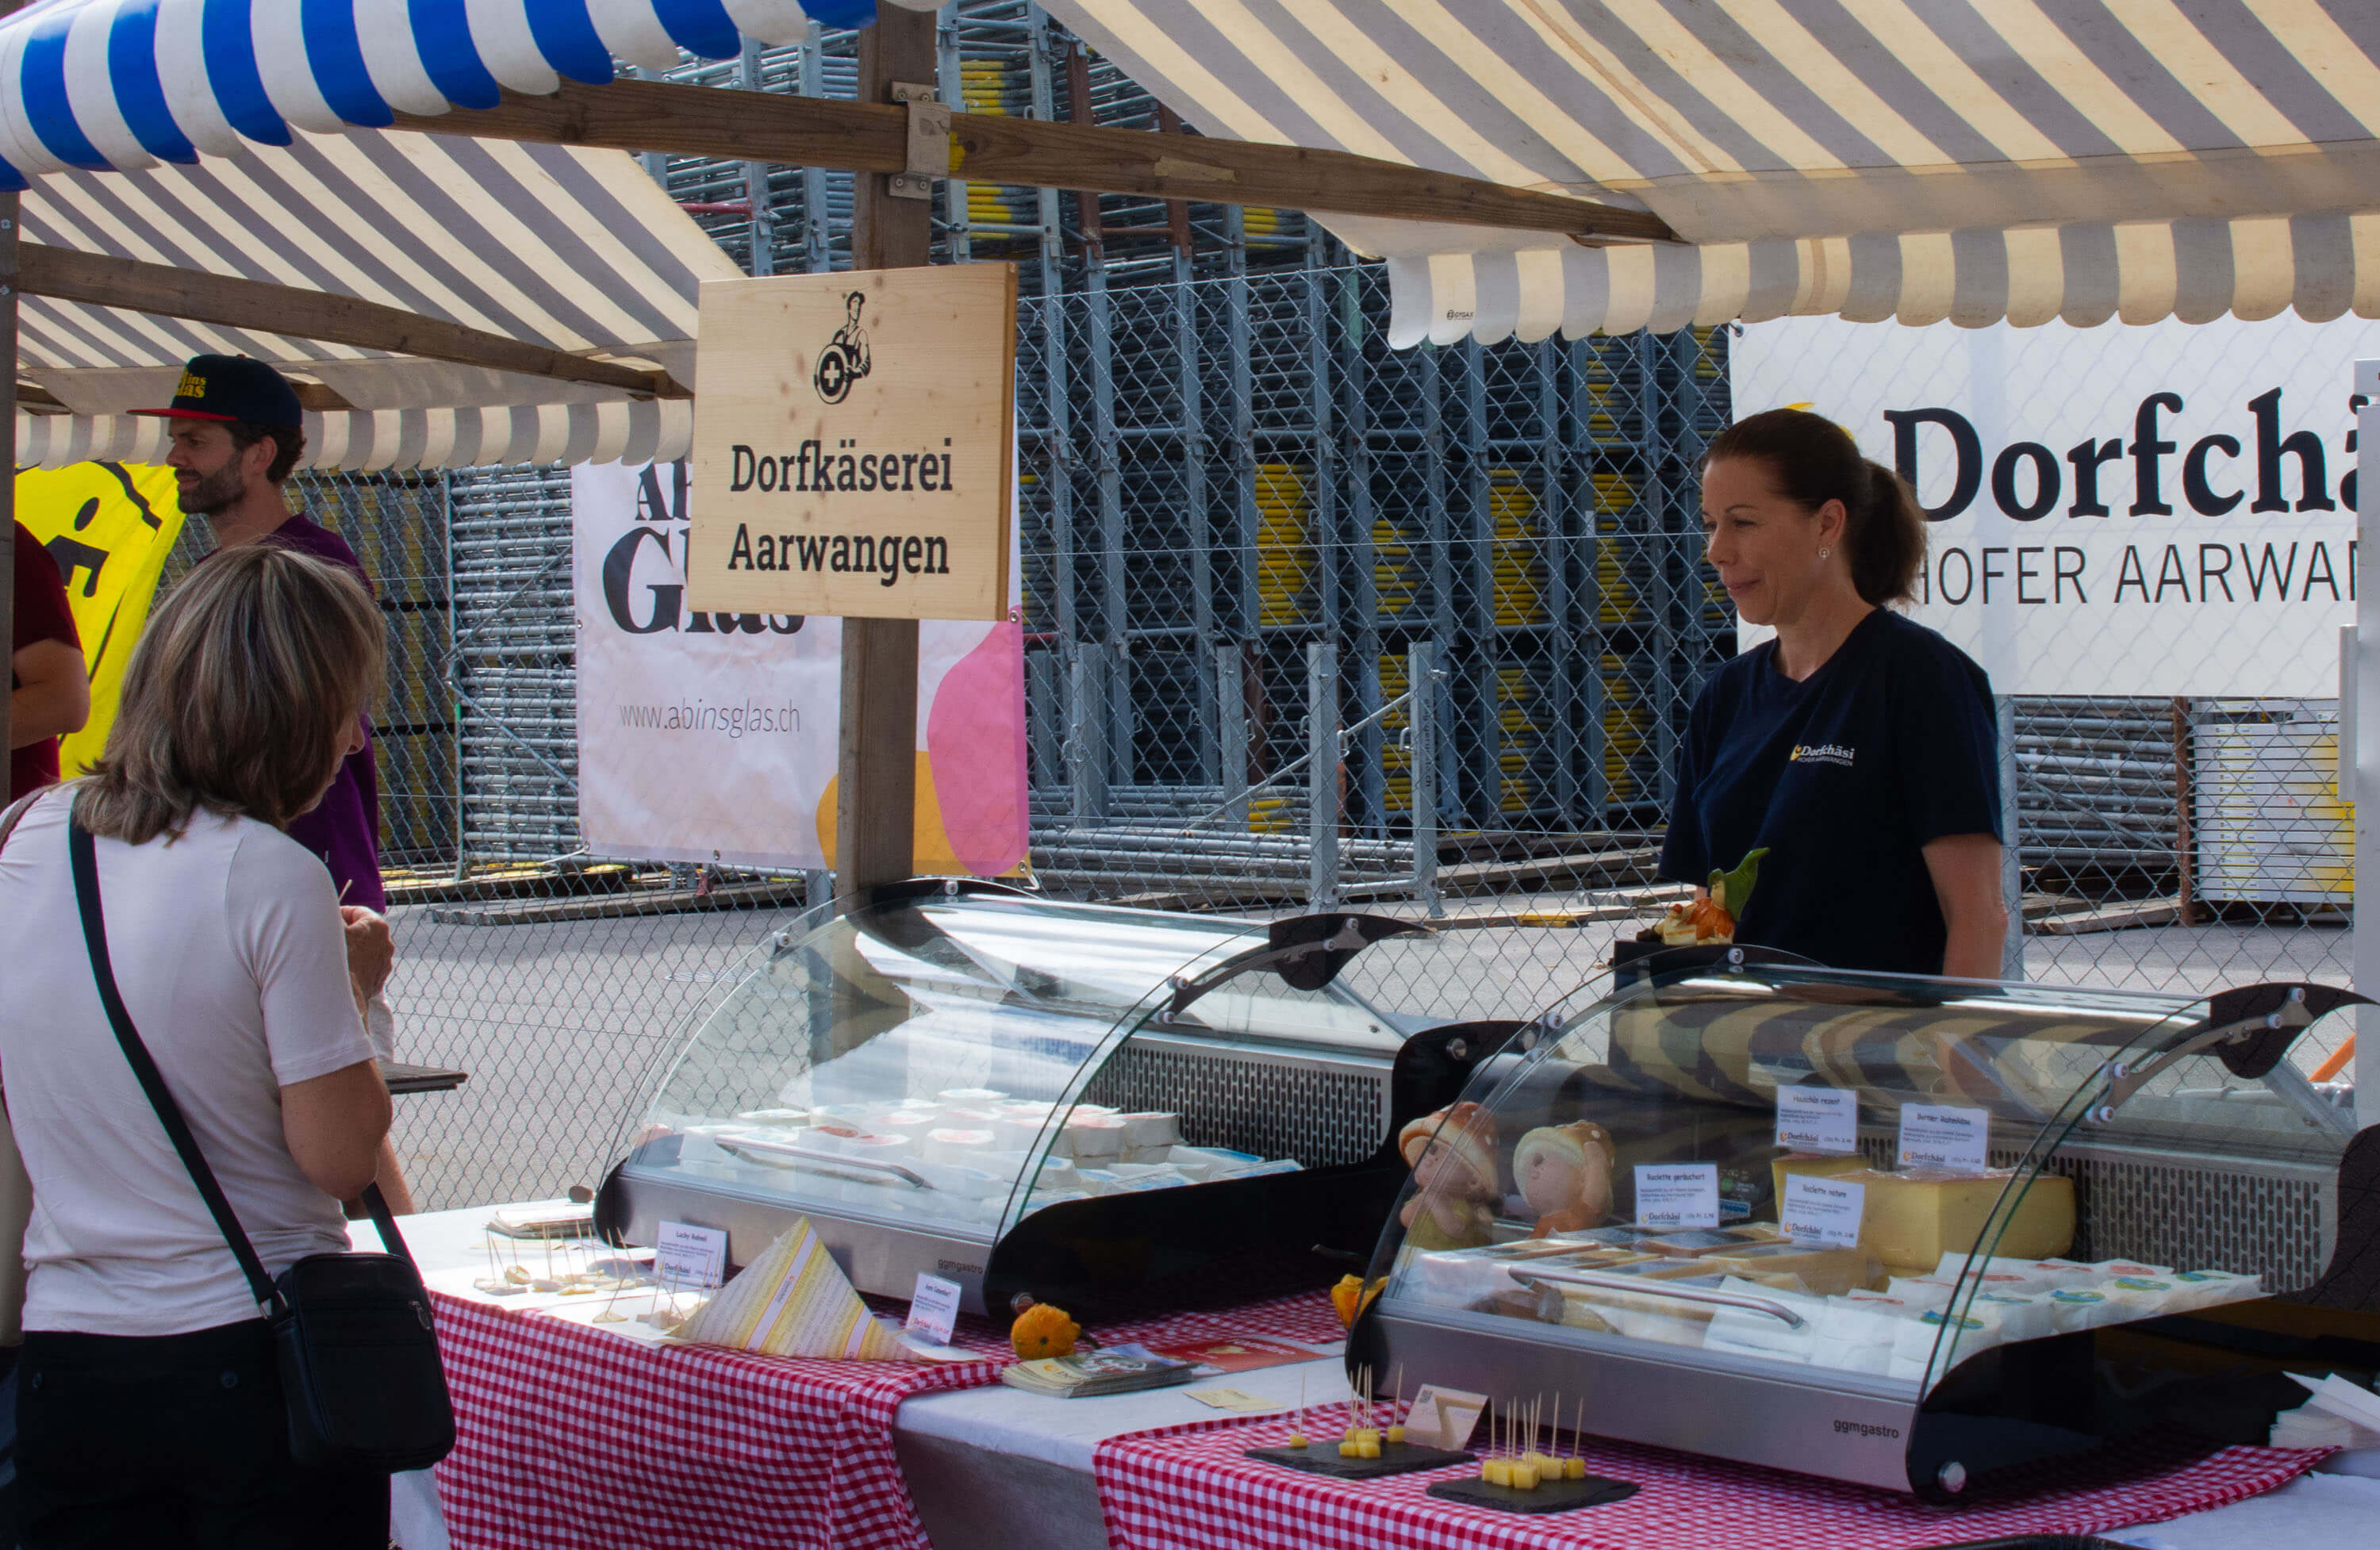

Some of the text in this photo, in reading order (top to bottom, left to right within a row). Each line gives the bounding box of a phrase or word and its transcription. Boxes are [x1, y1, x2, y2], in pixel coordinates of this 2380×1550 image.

[177, 376, 205, 398] las
[730, 437, 953, 493] Dorfkäserei
[727, 523, 950, 587] Aarwangen
[618, 697, 800, 739] www.abinsglas.ch
[1800, 744, 1856, 759] Dorfchäsi
[939, 1259, 984, 1274] ggmgastro
[1834, 1419, 1899, 1438] ggmgastro
